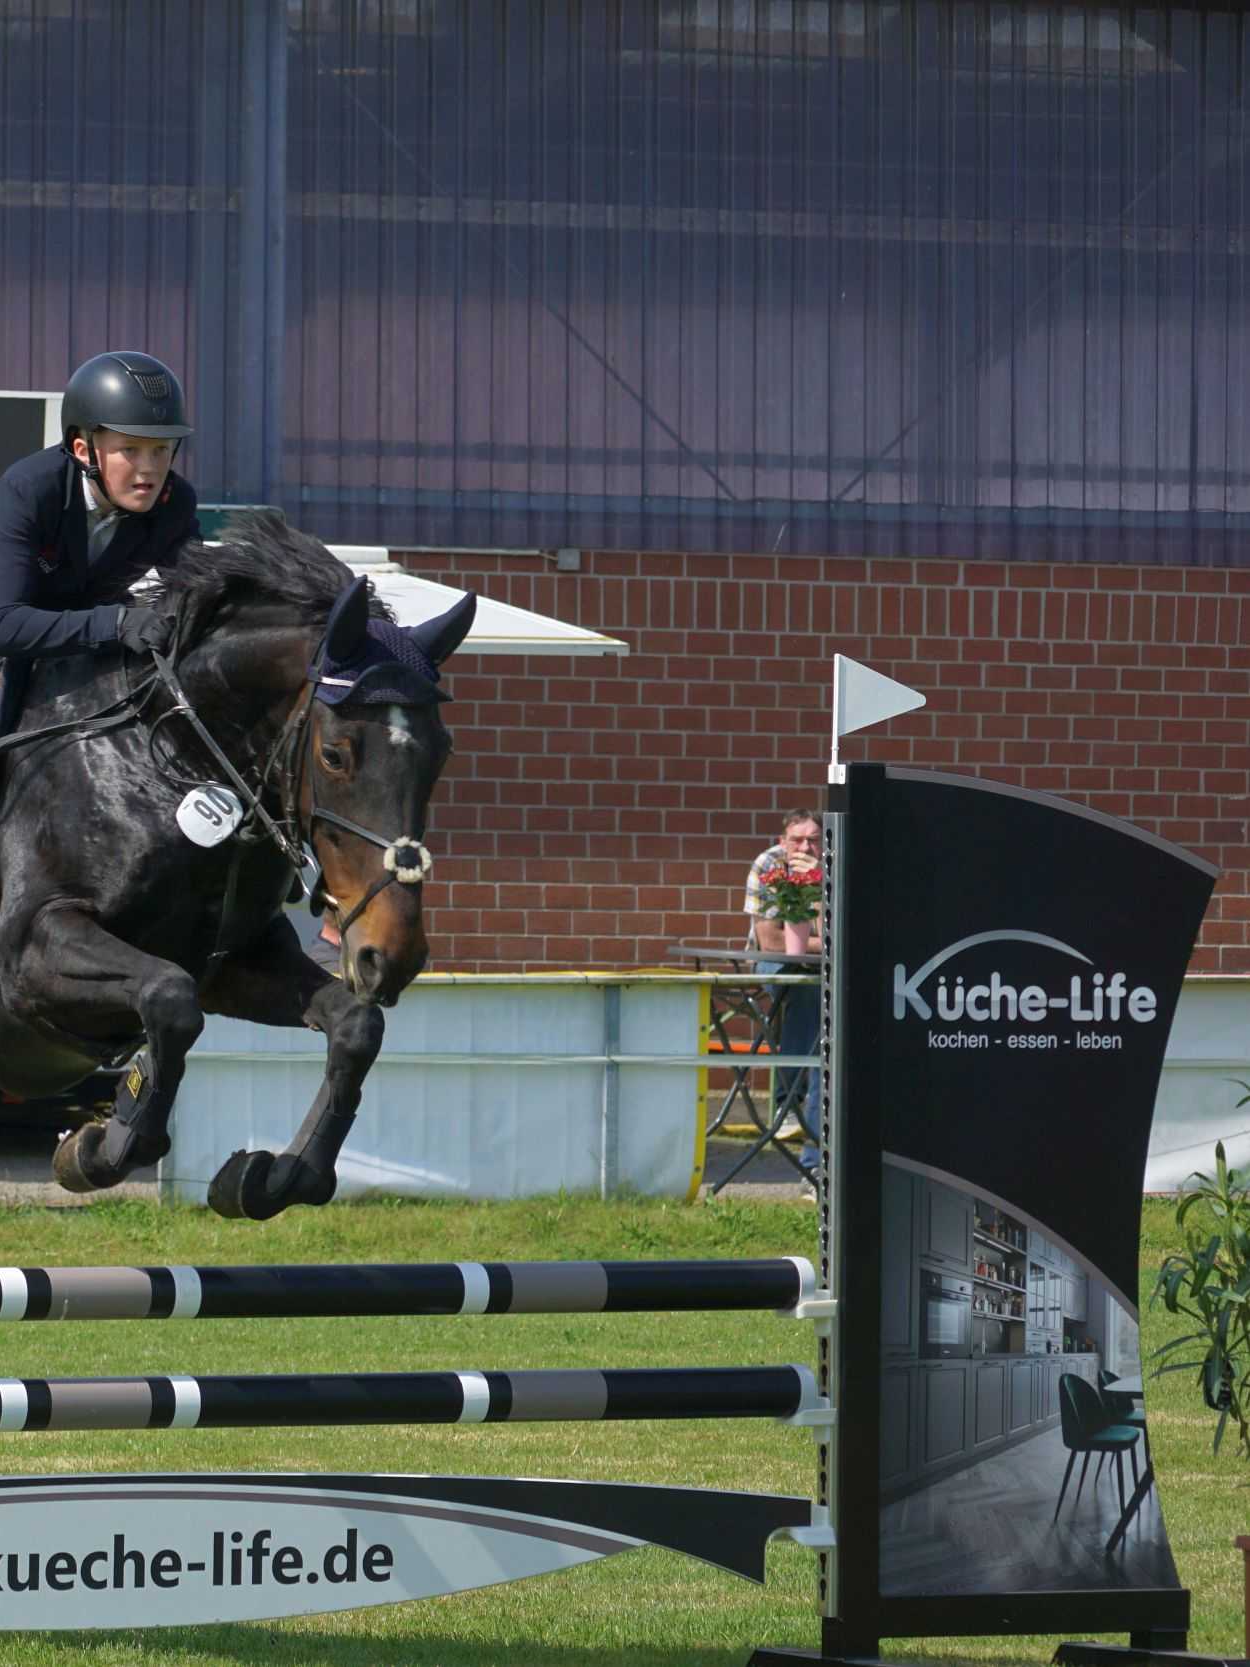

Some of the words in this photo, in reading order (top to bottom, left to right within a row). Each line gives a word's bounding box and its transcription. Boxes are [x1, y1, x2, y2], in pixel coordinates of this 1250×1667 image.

[194, 787, 234, 827] 90
[893, 963, 1157, 1022] Küche-Life
[928, 1030, 989, 1049] kochen
[1007, 1032, 1058, 1049] essen
[1076, 1031, 1122, 1050] leben
